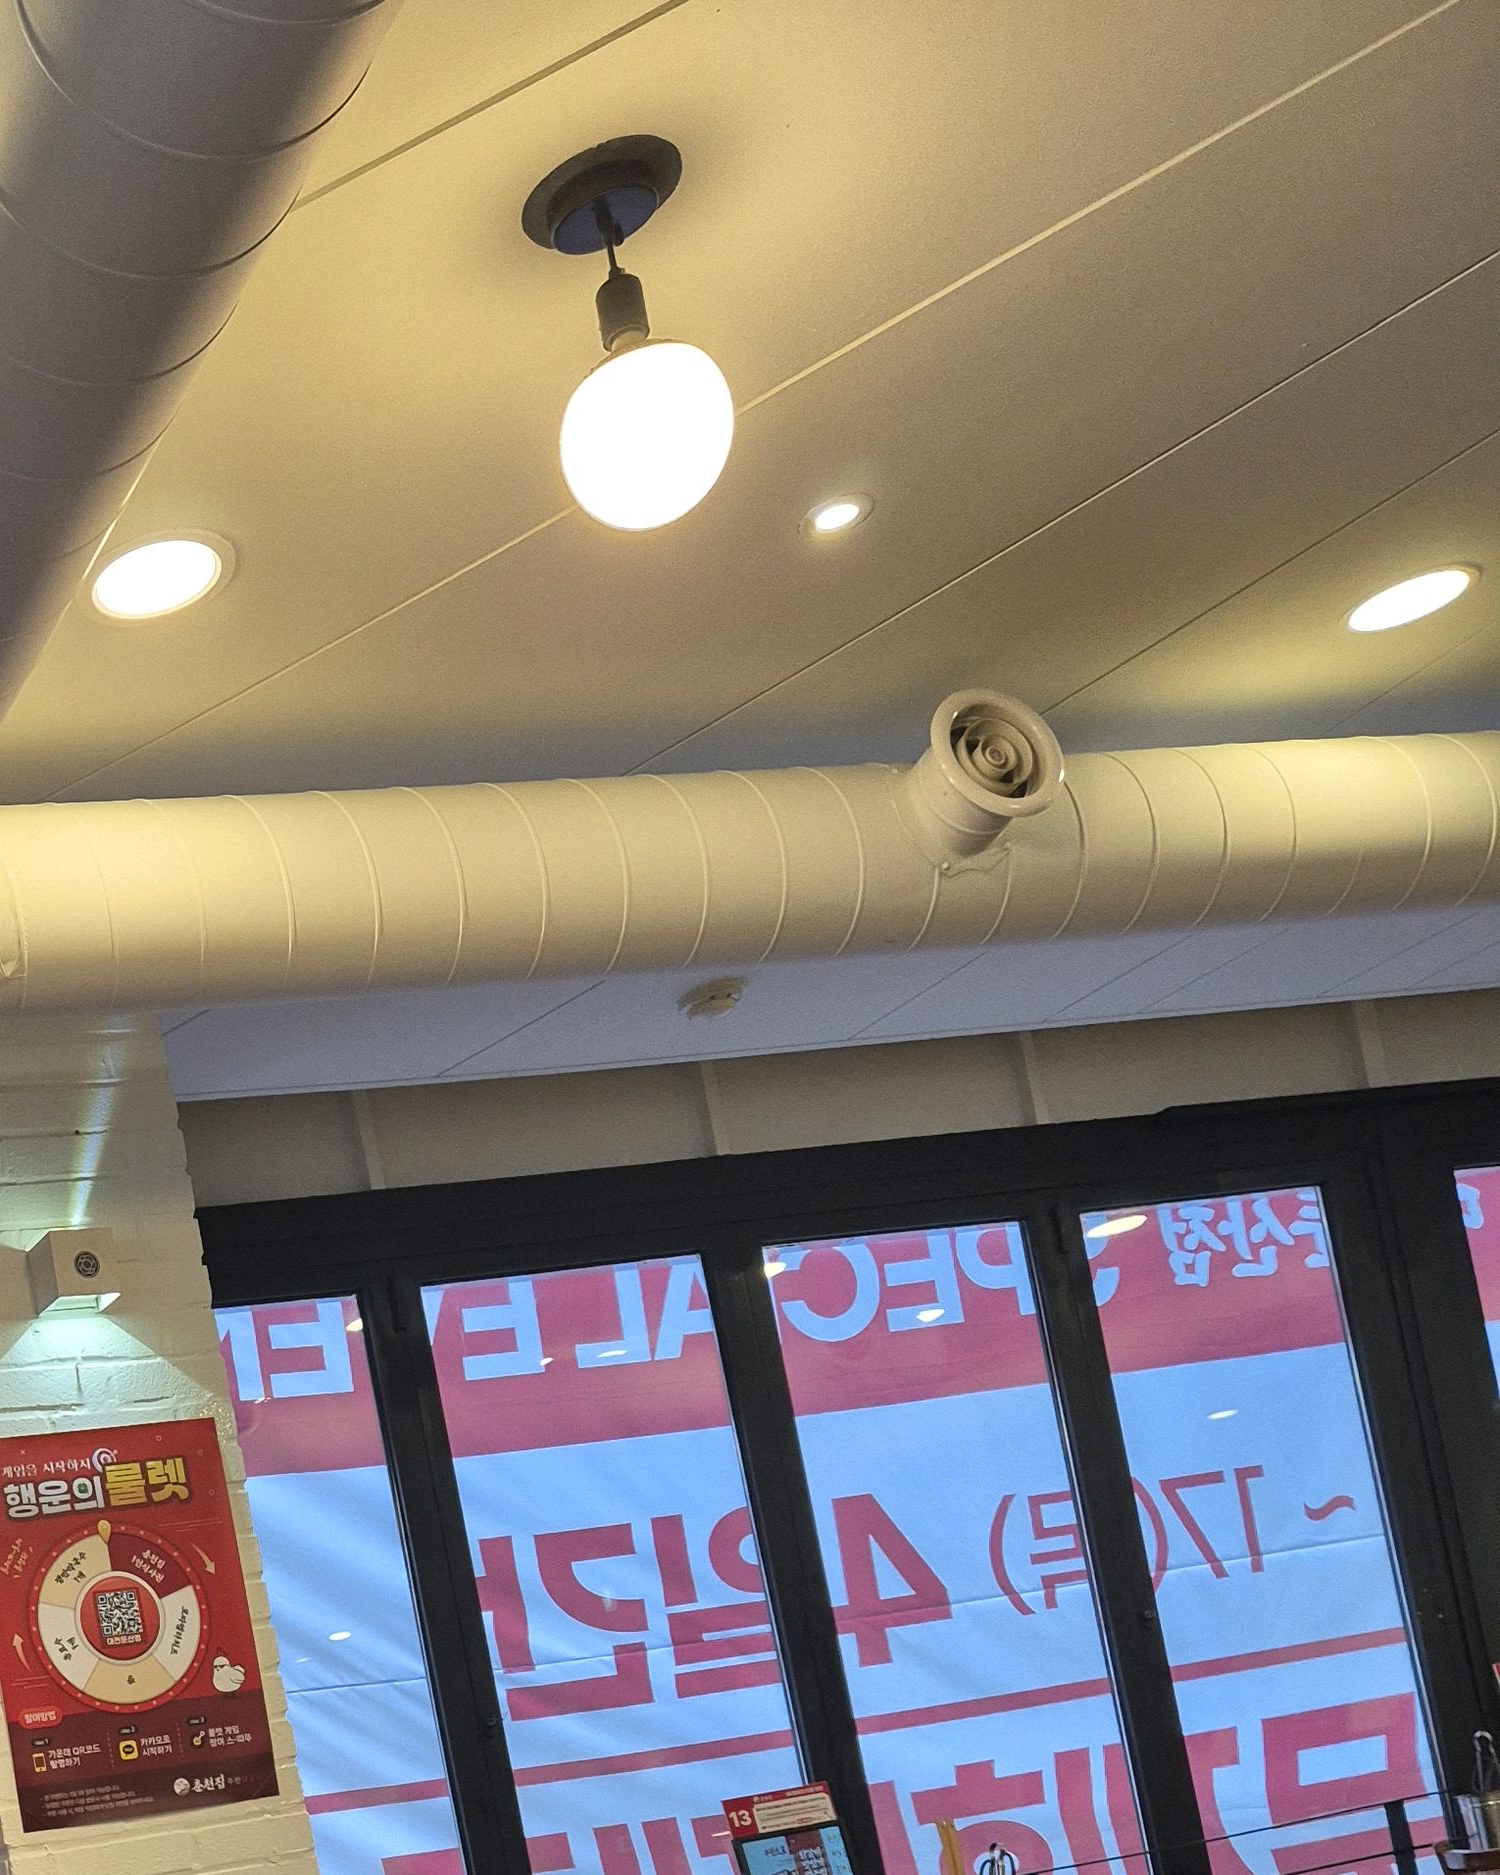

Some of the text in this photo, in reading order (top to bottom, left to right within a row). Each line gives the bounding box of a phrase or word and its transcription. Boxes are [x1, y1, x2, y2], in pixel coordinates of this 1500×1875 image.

[3, 1457, 190, 1518] 행운의 룰렛
[729, 1810, 752, 1828] 13
